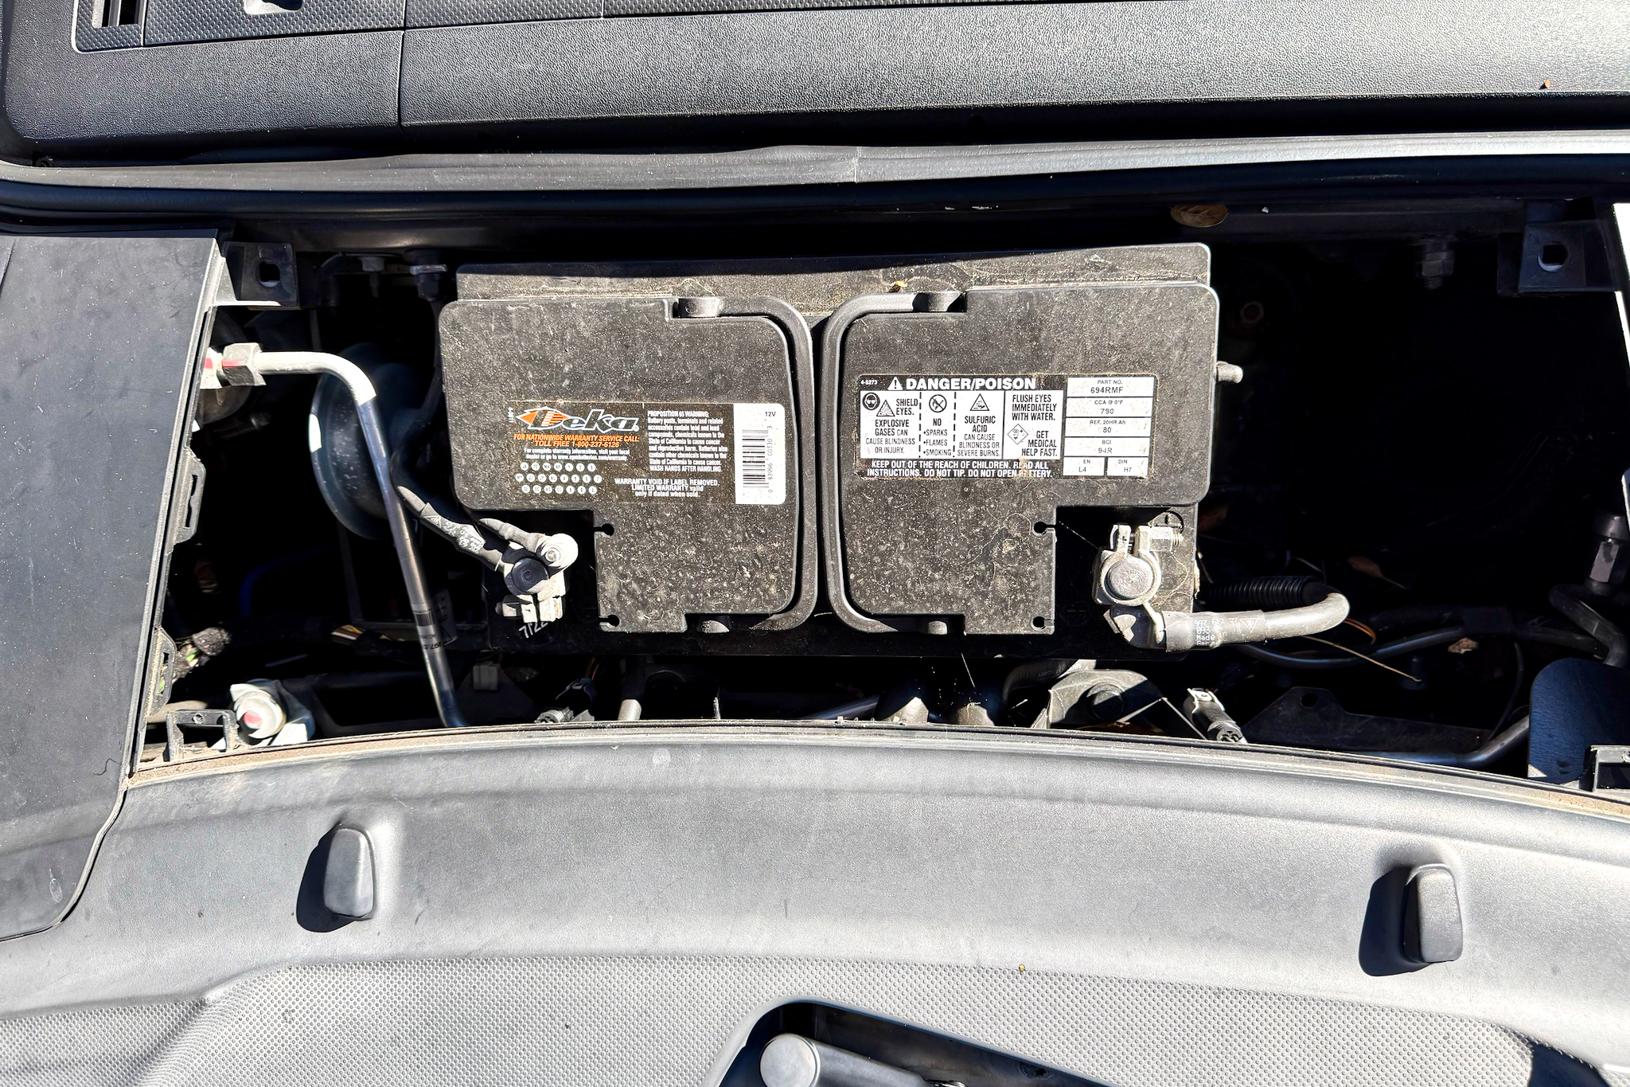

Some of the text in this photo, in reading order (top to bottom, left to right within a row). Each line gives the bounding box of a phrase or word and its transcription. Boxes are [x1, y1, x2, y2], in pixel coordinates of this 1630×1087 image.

[906, 378, 1036, 390] DANGER/POISON
[1090, 386, 1123, 394] 694RMF
[896, 398, 918, 406] SHIELD
[1013, 394, 1052, 402] FLUSH EYES
[896, 408, 915, 416] EYES.
[964, 416, 996, 424] SULFURIC
[1012, 413, 1056, 421] WITH WATER.
[875, 419, 909, 427] EXPLOSIVE
[933, 418, 942, 426] NO
[875, 428, 908, 436] GASES CAN
[1022, 448, 1057, 456] HELP FAST.
[872, 460, 889, 469] KEEP
[891, 460, 907, 469] OUT
[908, 460, 917, 469] OF
[920, 460, 933, 469] THE
[935, 460, 958, 469] REACH
[960, 460, 970, 469] OF
[972, 460, 1011, 469] CHILDREN.
[1035, 461, 1049, 469] ALL
[867, 469, 921, 477] INSTRUCTIONS.
[924, 469, 935, 477] DO
[936, 469, 953, 477] NOT
[954, 469, 965, 477] TIP.
[968, 469, 979, 477] DO
[980, 469, 996, 477] NOT
[997, 469, 1017, 477] OPEN
